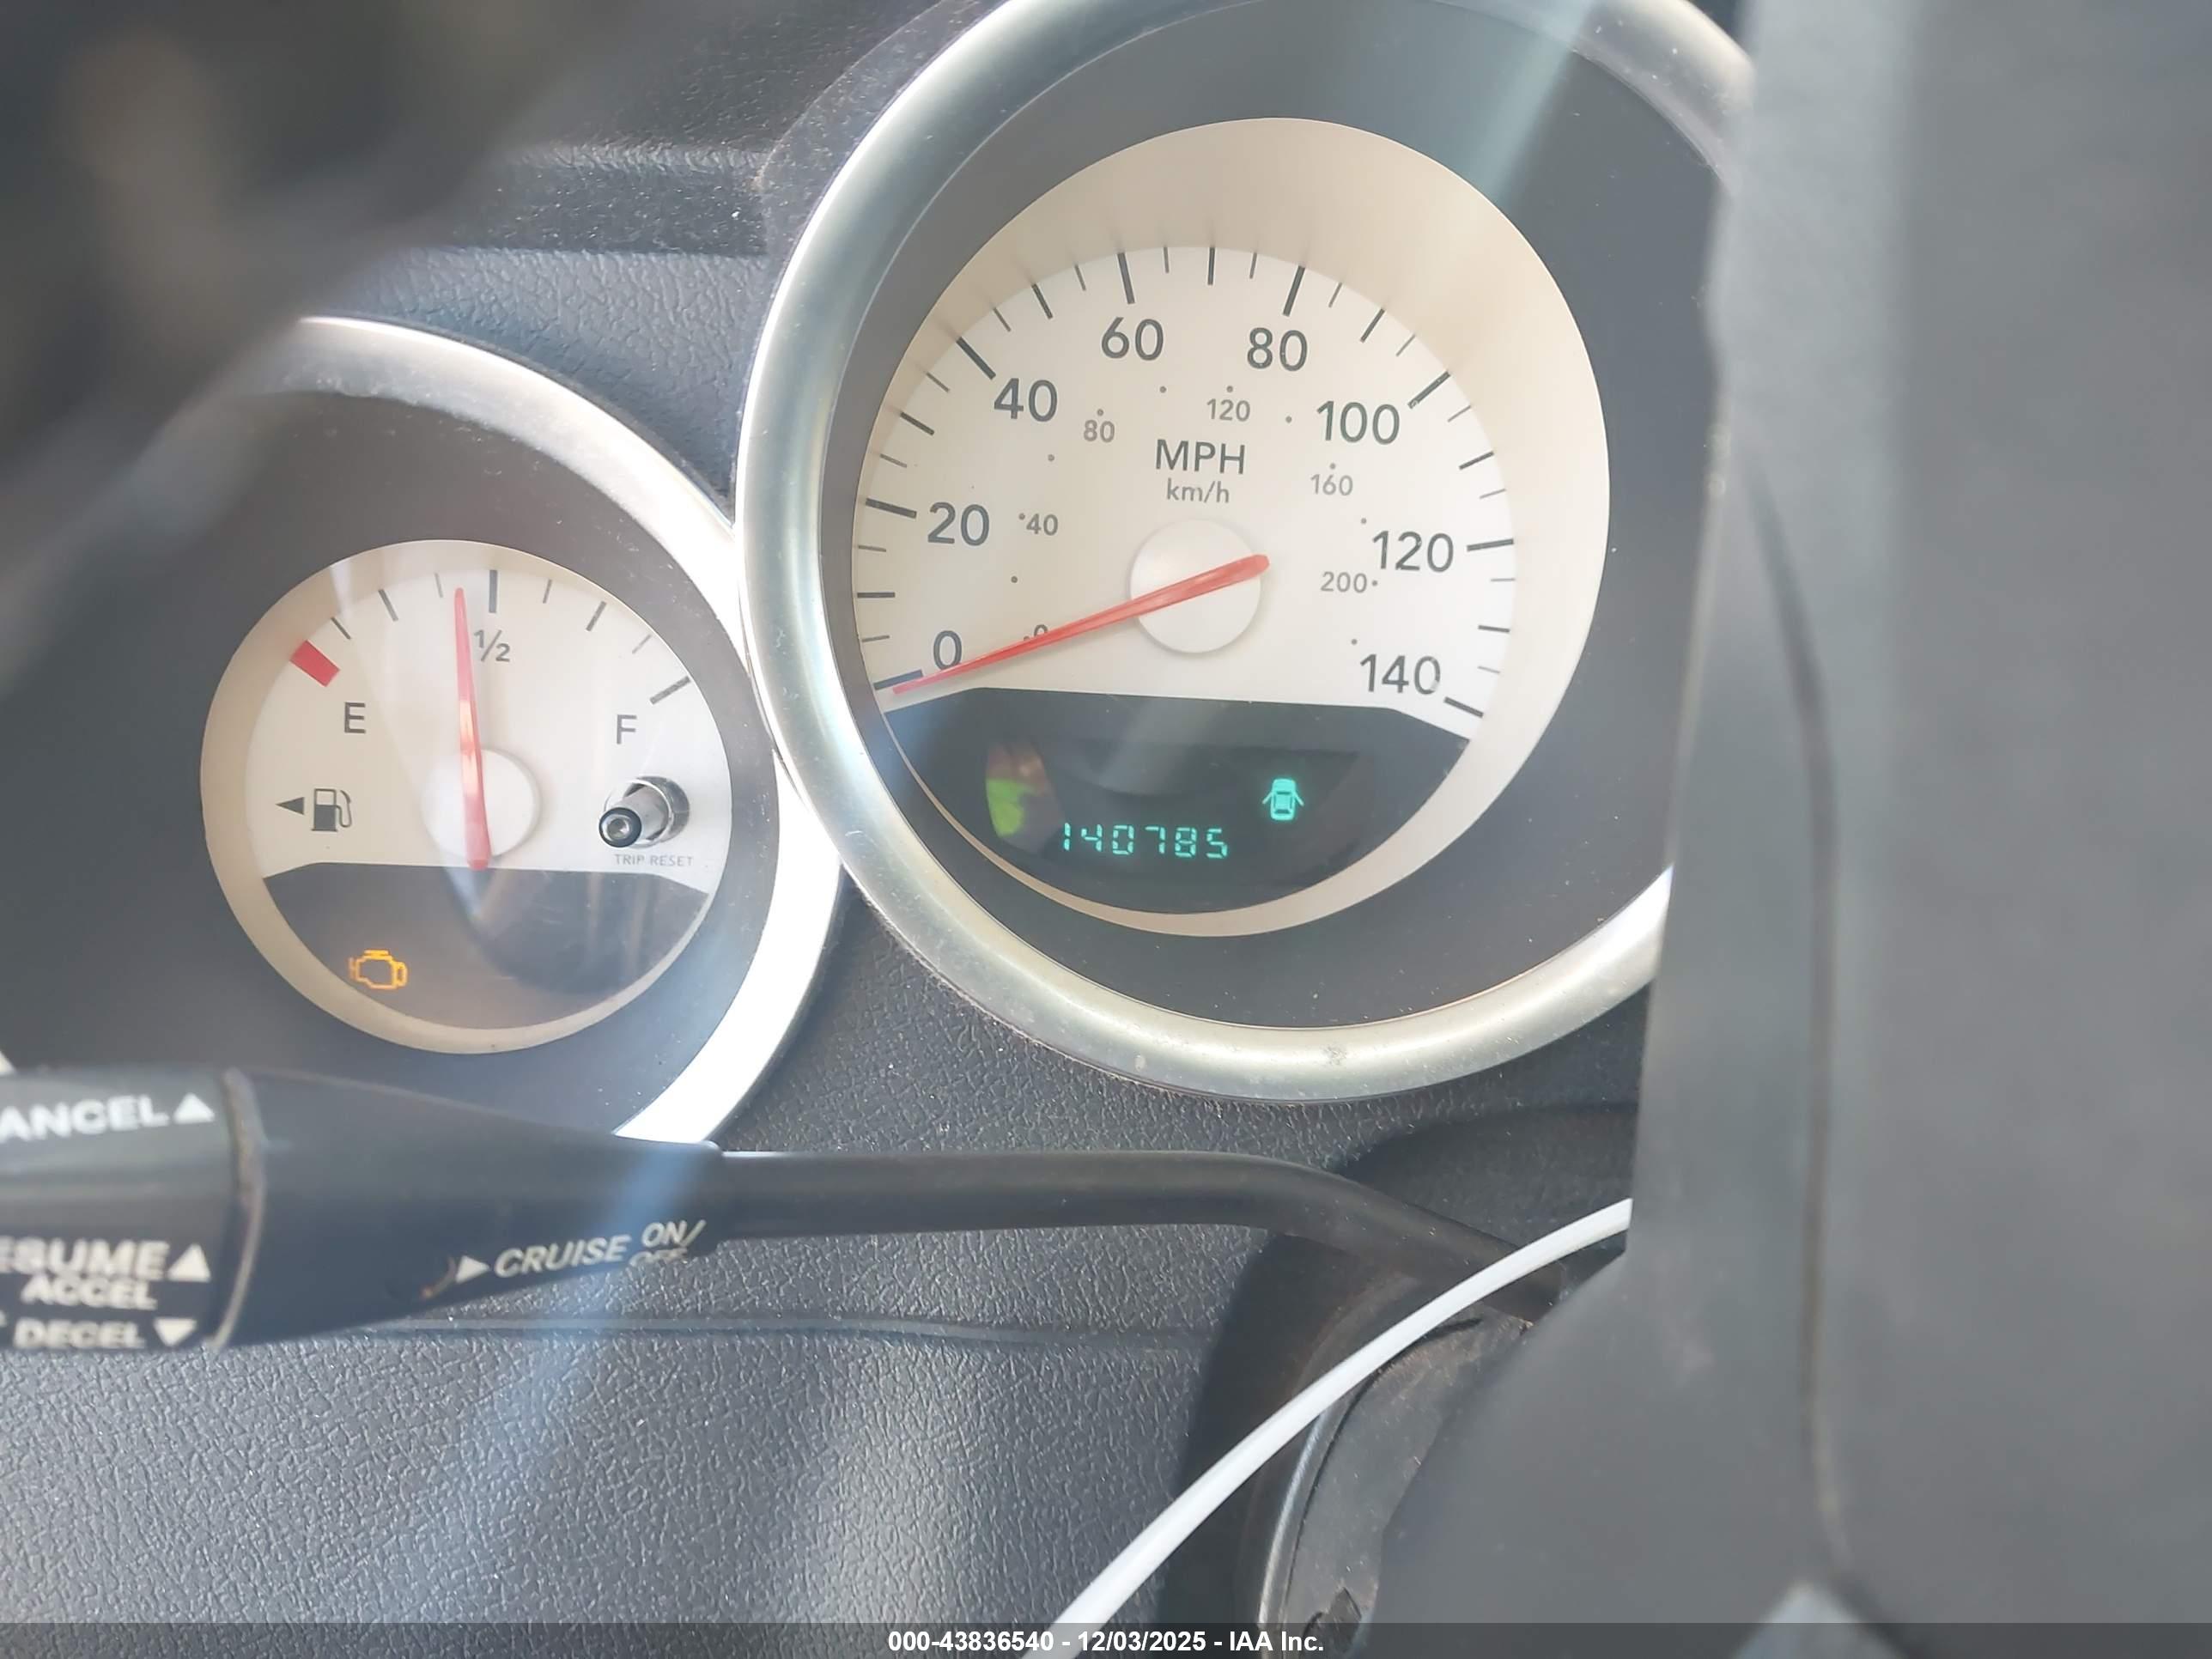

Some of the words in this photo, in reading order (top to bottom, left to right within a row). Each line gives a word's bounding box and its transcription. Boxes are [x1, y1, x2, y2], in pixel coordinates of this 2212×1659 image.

[1103, 319, 1164, 362] 60
[1249, 329, 1308, 372] 80
[994, 378, 1058, 422] 40
[1208, 400, 1251, 422] 120
[1085, 421, 1115, 443] 80
[1318, 402, 1400, 445] 100
[1158, 441, 1245, 475] MPH
[1168, 479, 1230, 503] km/h
[1312, 475, 1353, 496] 160
[929, 503, 990, 546] 20
[1028, 515, 1059, 536] 40
[1374, 532, 1454, 573] 120
[1322, 573, 1368, 593] 200
[934, 632, 963, 670] 0
[1361, 655, 1441, 696] 140
[345, 703, 366, 734] E
[617, 715, 637, 744] F
[1064, 822, 1228, 858] 140785
[614, 854, 645, 866] TRIP
[650, 854, 694, 866] RESET
[495, 1235, 632, 1279] CRUISE
[641, 1219, 707, 1248] ON/
[21, 1273, 158, 1310] ACCEL
[13, 1318, 146, 1349] DECEL
